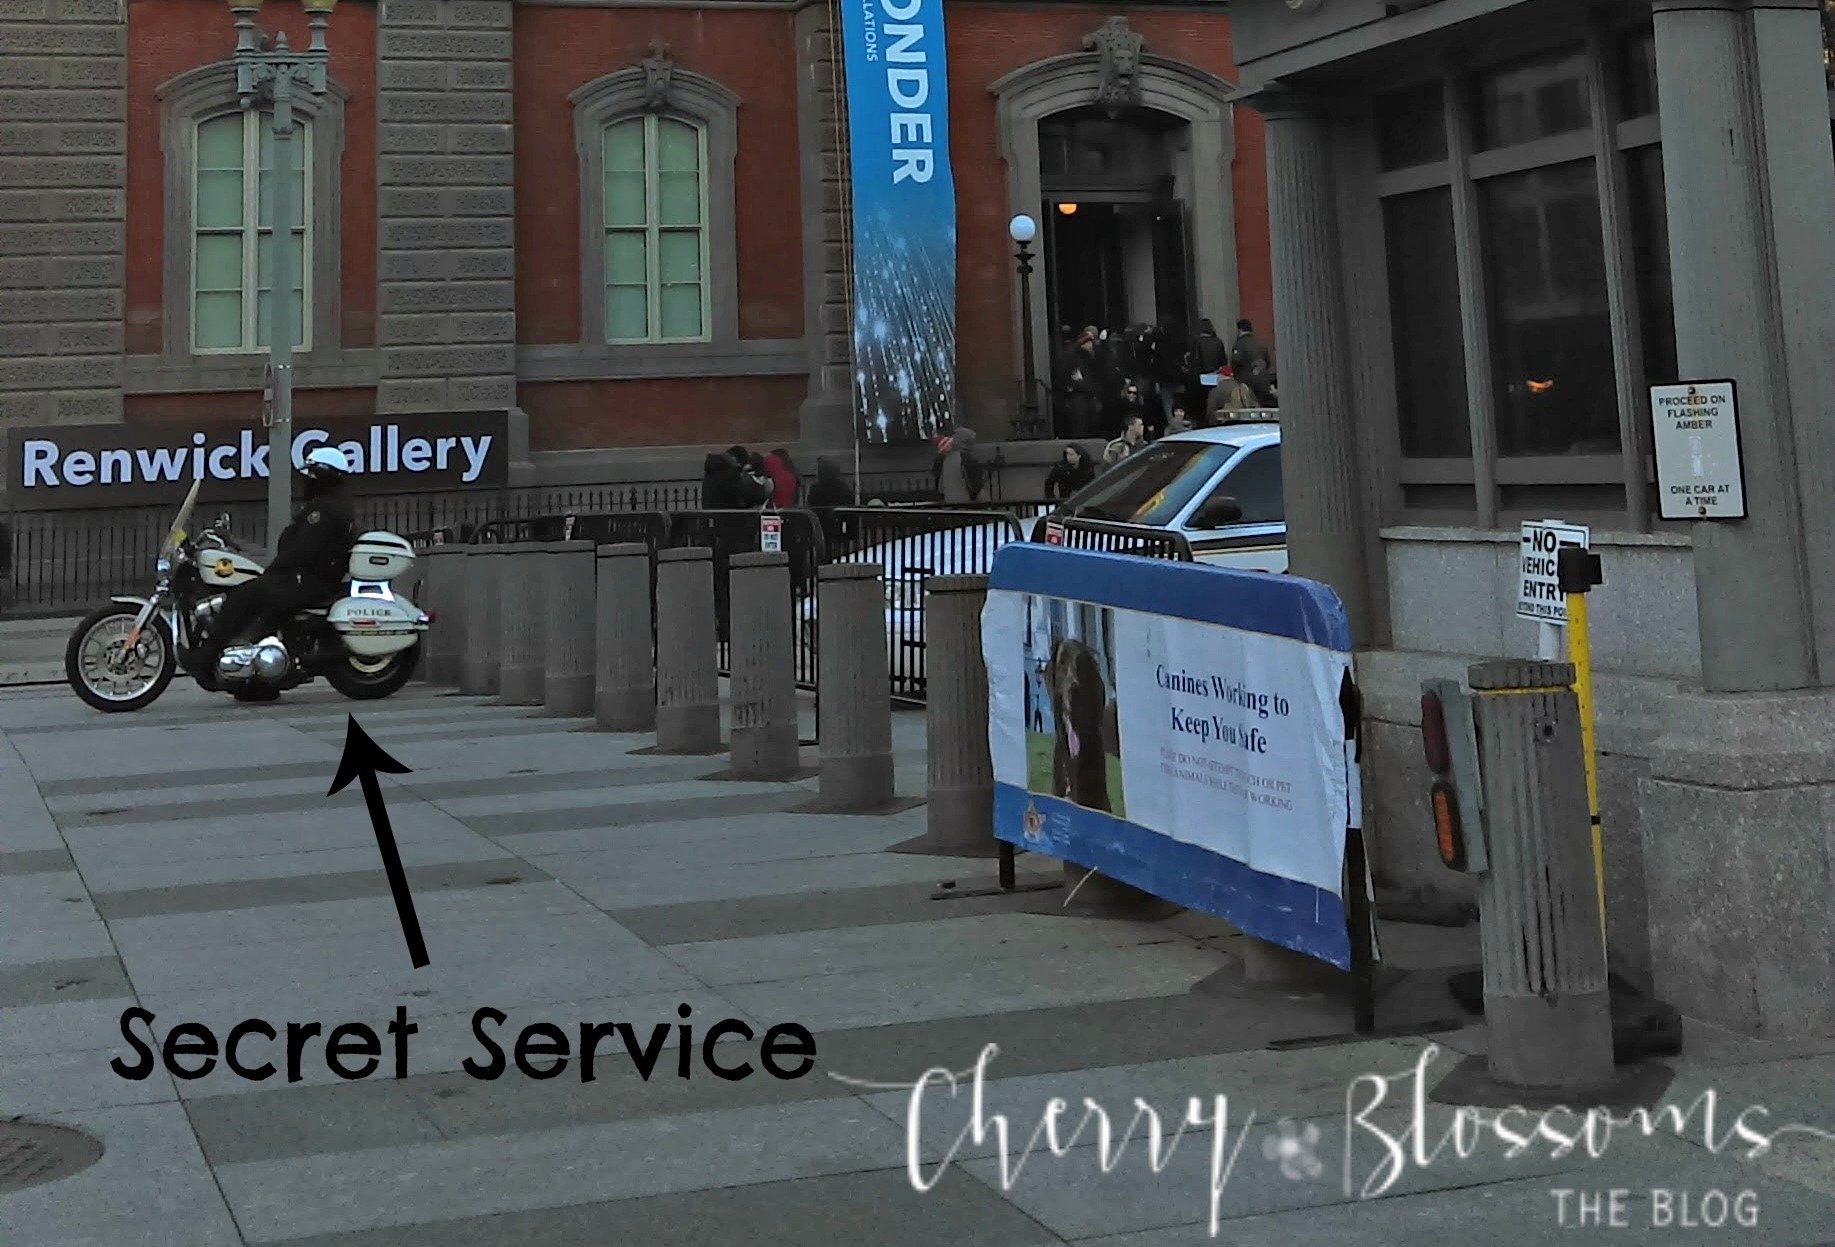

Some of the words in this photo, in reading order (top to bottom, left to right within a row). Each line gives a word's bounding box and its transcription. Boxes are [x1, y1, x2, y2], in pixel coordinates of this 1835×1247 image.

[1659, 396, 1708, 406] PROCEED
[1710, 395, 1726, 404] ON
[1667, 408, 1719, 418] FLASHING
[1675, 420, 1713, 430] AMBER
[22, 430, 269, 486] Renwick
[1670, 485, 1691, 495] ONE
[1694, 484, 1715, 494] CAR
[1717, 484, 1730, 493] AT
[1685, 497, 1693, 505] A
[1695, 496, 1718, 506] TIME
[1533, 530, 1557, 553] NO
[1522, 556, 1557, 577] VEHIC
[347, 609, 391, 617] POLICE
[1156, 663, 1209, 697] Canines
[1211, 675, 1269, 719] Working
[1274, 692, 1289, 716] to
[1172, 707, 1209, 743] Keep
[1212, 716, 1236, 745] You
